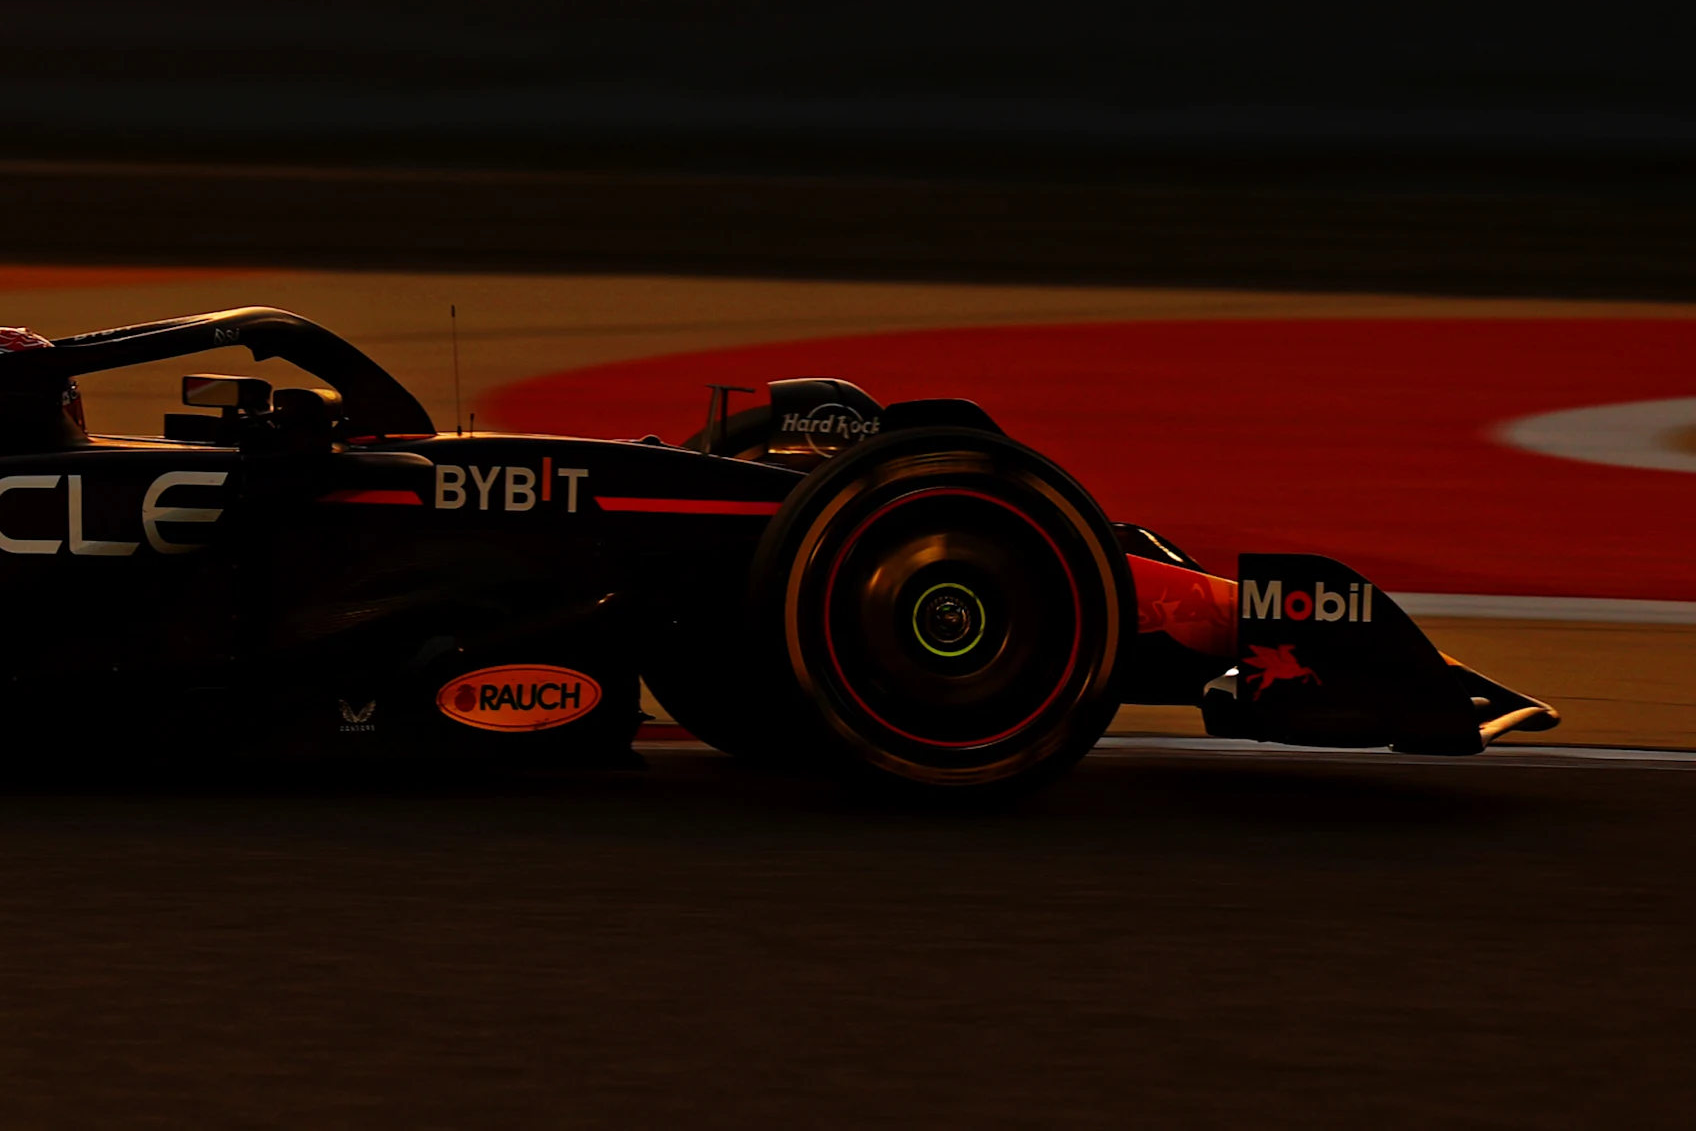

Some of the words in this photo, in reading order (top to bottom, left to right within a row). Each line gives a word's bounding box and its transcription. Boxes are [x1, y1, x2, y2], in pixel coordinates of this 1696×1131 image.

[781, 413, 836, 433] Hard
[836, 415, 882, 440] Rock
[434, 456, 590, 514] BYBIT
[1241, 579, 1374, 622] Mobil
[480, 683, 581, 711] RAUCH
